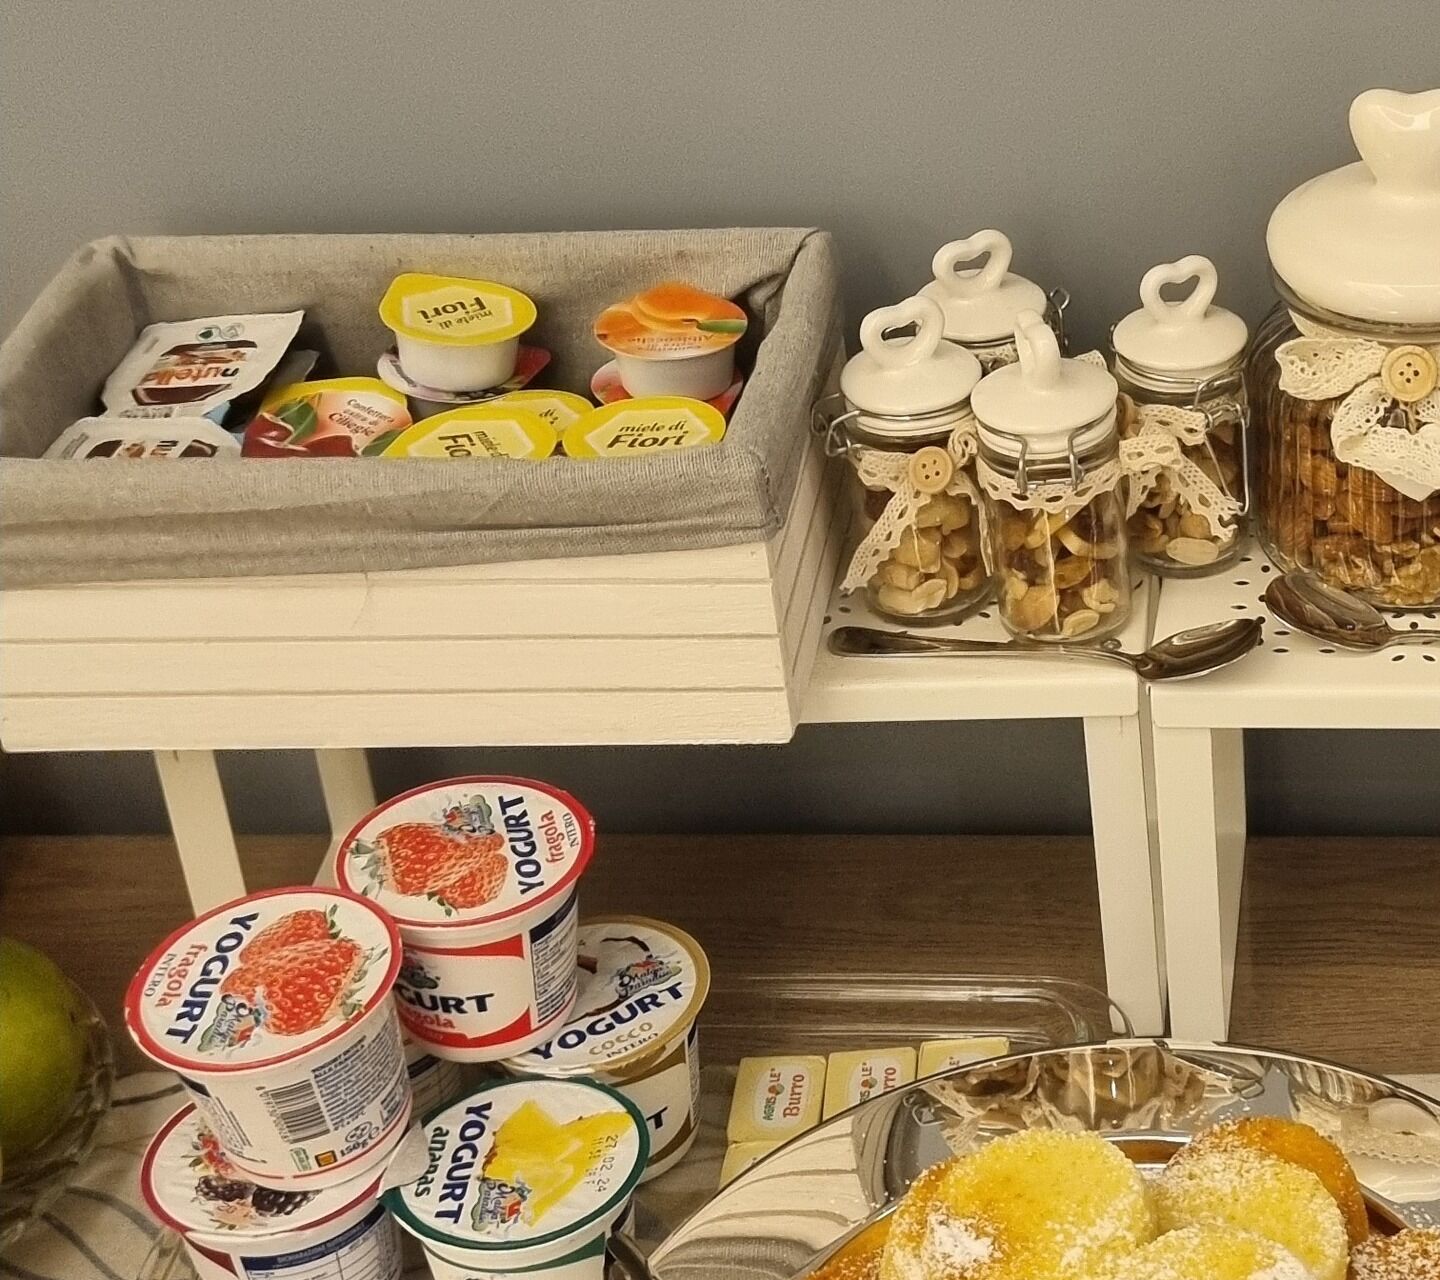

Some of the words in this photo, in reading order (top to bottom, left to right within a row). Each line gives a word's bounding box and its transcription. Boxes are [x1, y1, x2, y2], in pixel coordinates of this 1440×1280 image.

[417, 296, 488, 324] Fiori
[437, 433, 476, 458] Fio
[607, 429, 690, 449] Fiori
[618, 421, 665, 433] miele
[668, 419, 688, 432] di
[498, 794, 545, 895] YOGURT
[537, 810, 565, 863] fragola
[144, 952, 178, 998] INTERO
[155, 943, 208, 1008] fragola
[165, 912, 260, 1045] YOGURT
[529, 981, 684, 1061] YOGURT
[588, 1022, 654, 1057] COCCO
[605, 1032, 660, 1059] INTERO
[783, 1073, 805, 1118] Burro
[414, 1126, 450, 1198] ananas
[434, 1101, 493, 1224] YOGURT
